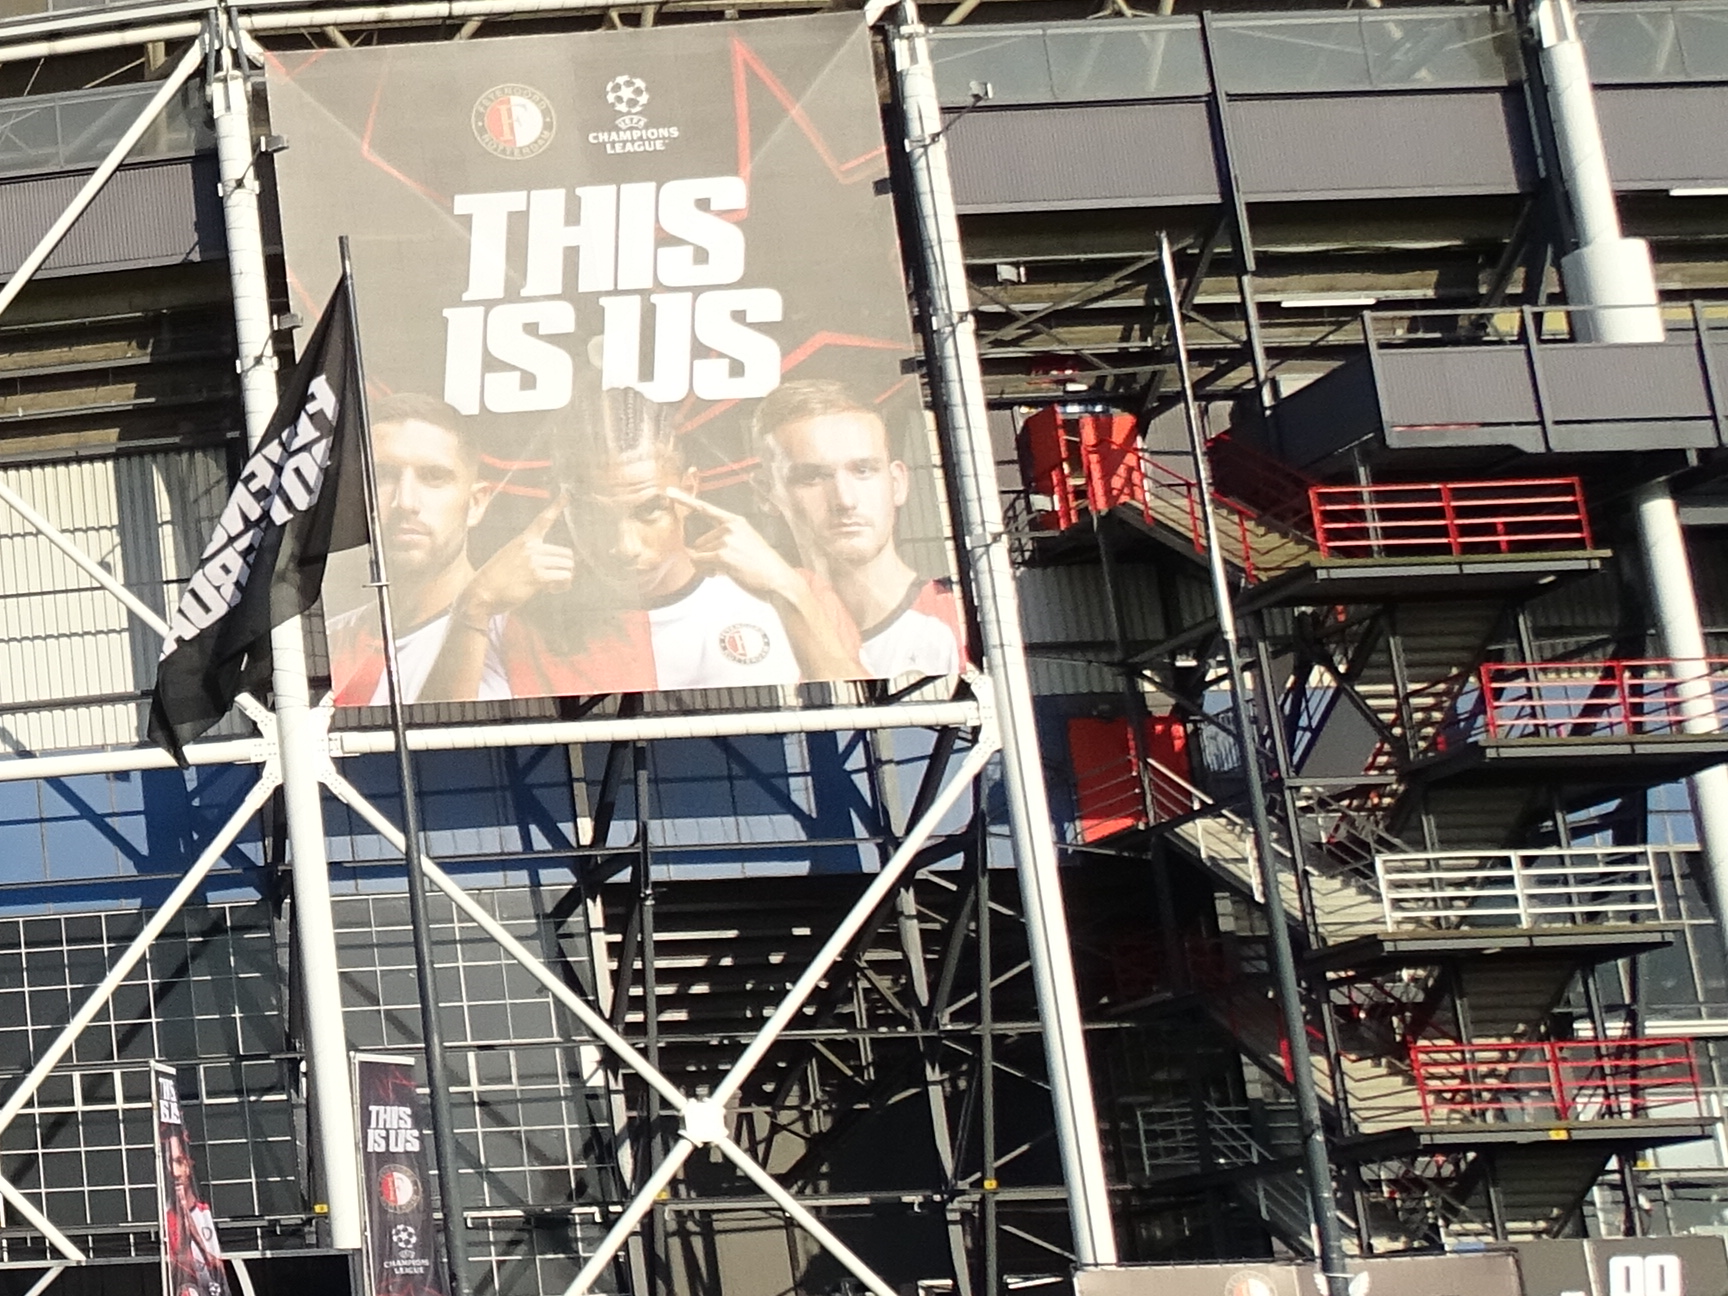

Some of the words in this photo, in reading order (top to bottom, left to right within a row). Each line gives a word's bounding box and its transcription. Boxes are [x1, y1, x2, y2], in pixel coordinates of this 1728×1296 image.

[588, 126, 680, 144] CHAMPIONS
[605, 139, 665, 155] LEAGUE
[454, 175, 748, 302] THIS
[442, 300, 575, 416] IS
[599, 287, 783, 403] US
[369, 1106, 412, 1129] THIS
[367, 1129, 386, 1152] IS
[389, 1129, 420, 1152] US
